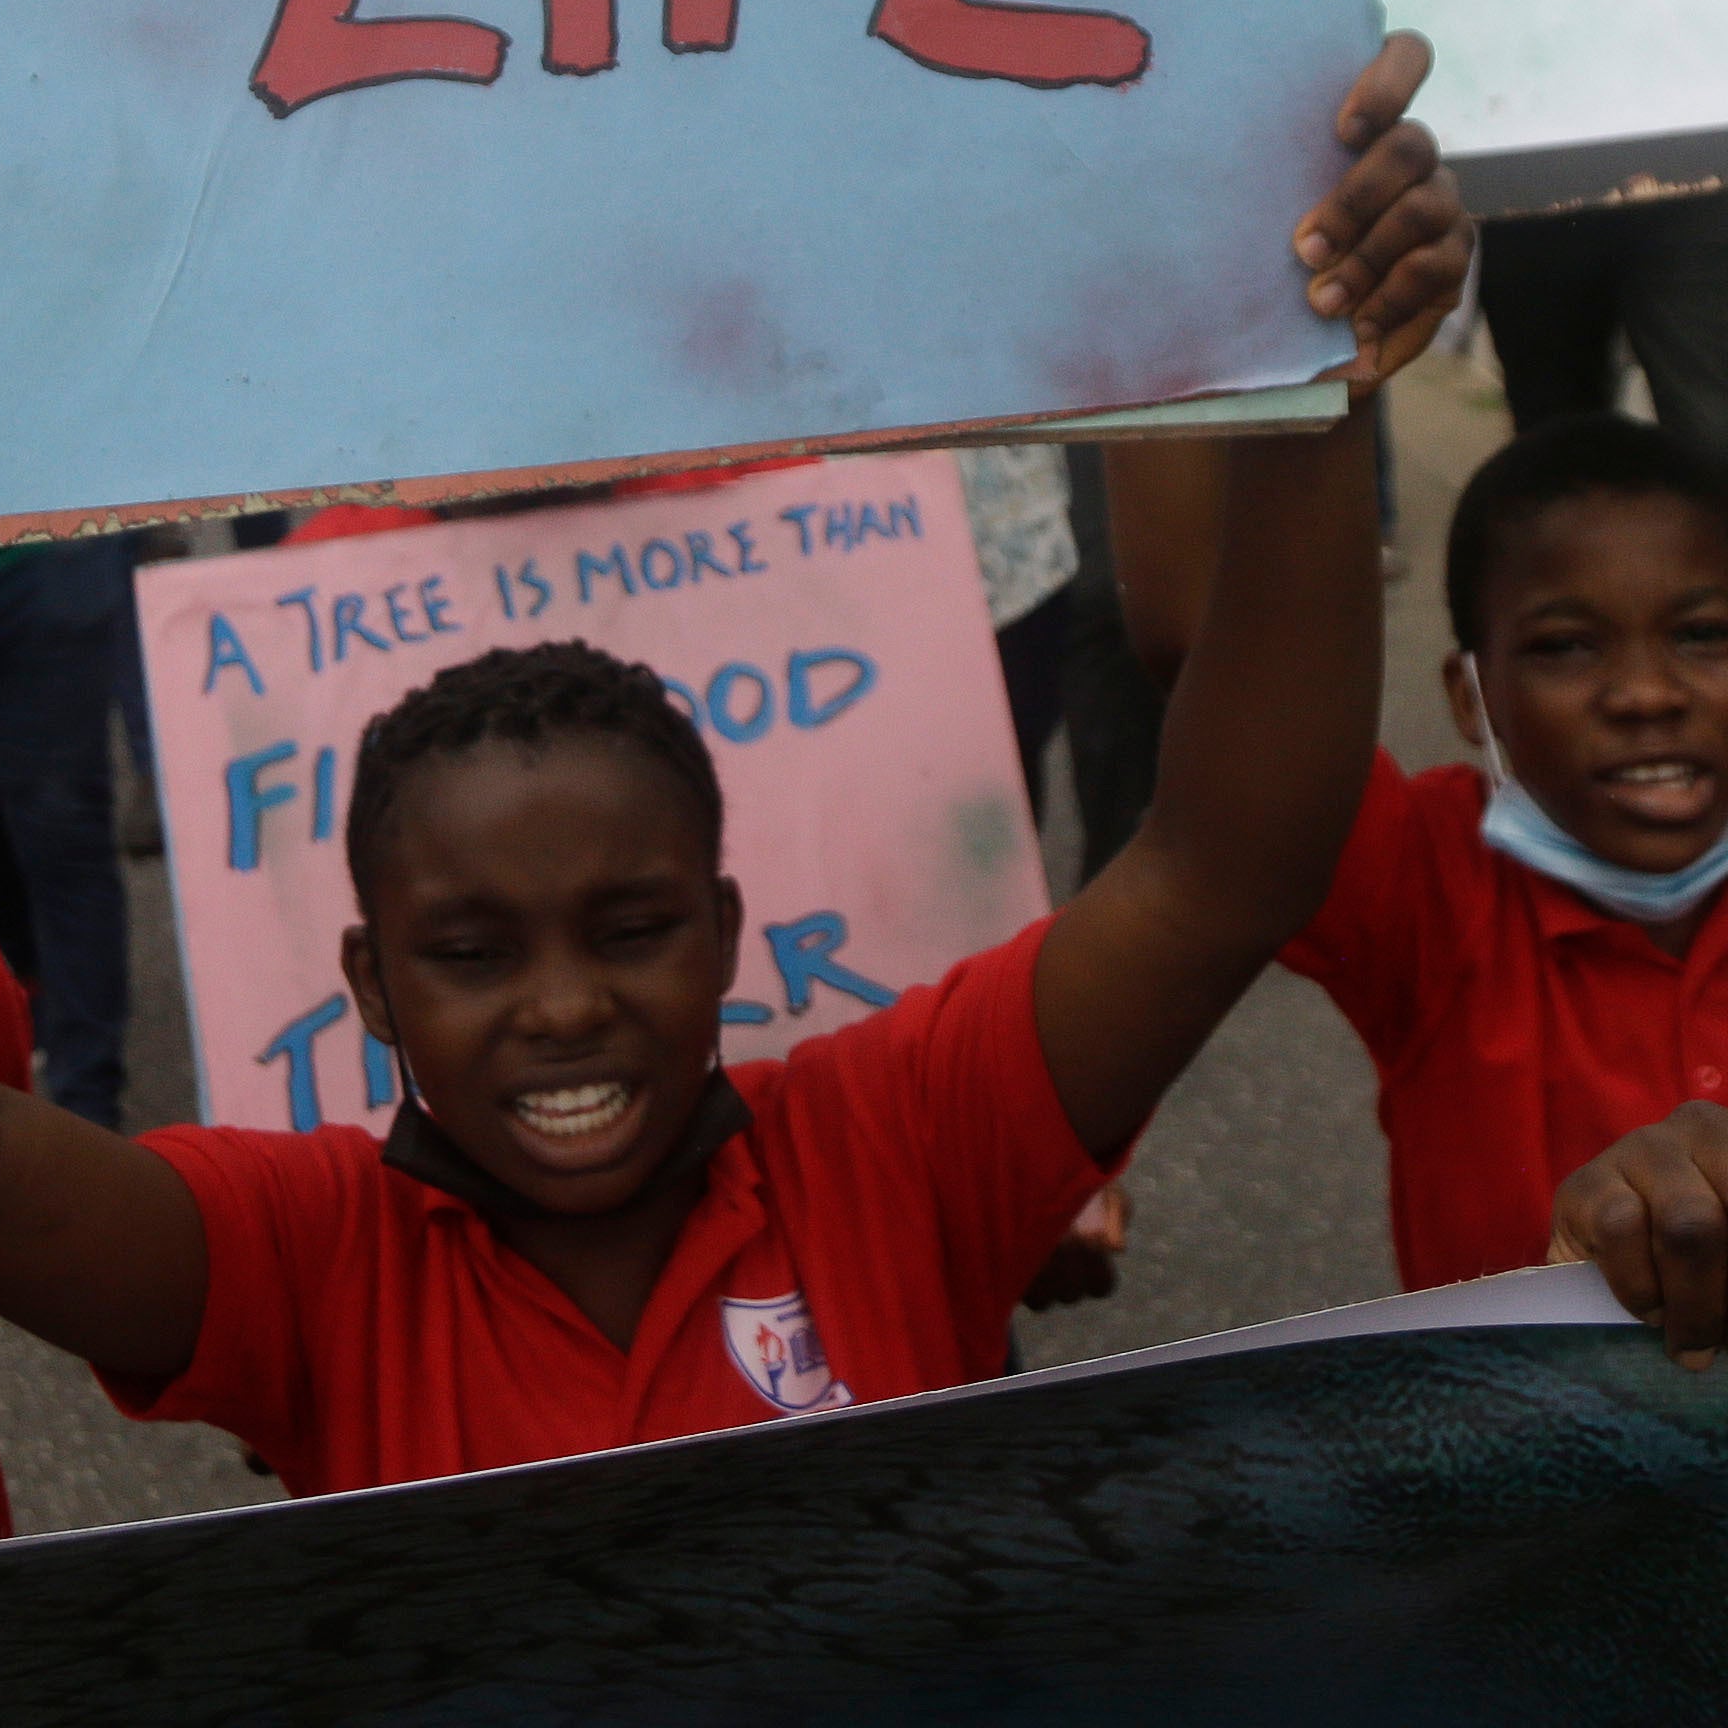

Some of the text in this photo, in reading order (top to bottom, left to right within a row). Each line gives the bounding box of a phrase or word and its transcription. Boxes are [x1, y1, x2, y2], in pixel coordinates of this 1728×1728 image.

[204, 494, 924, 696] A TREE IS MORE THAN
